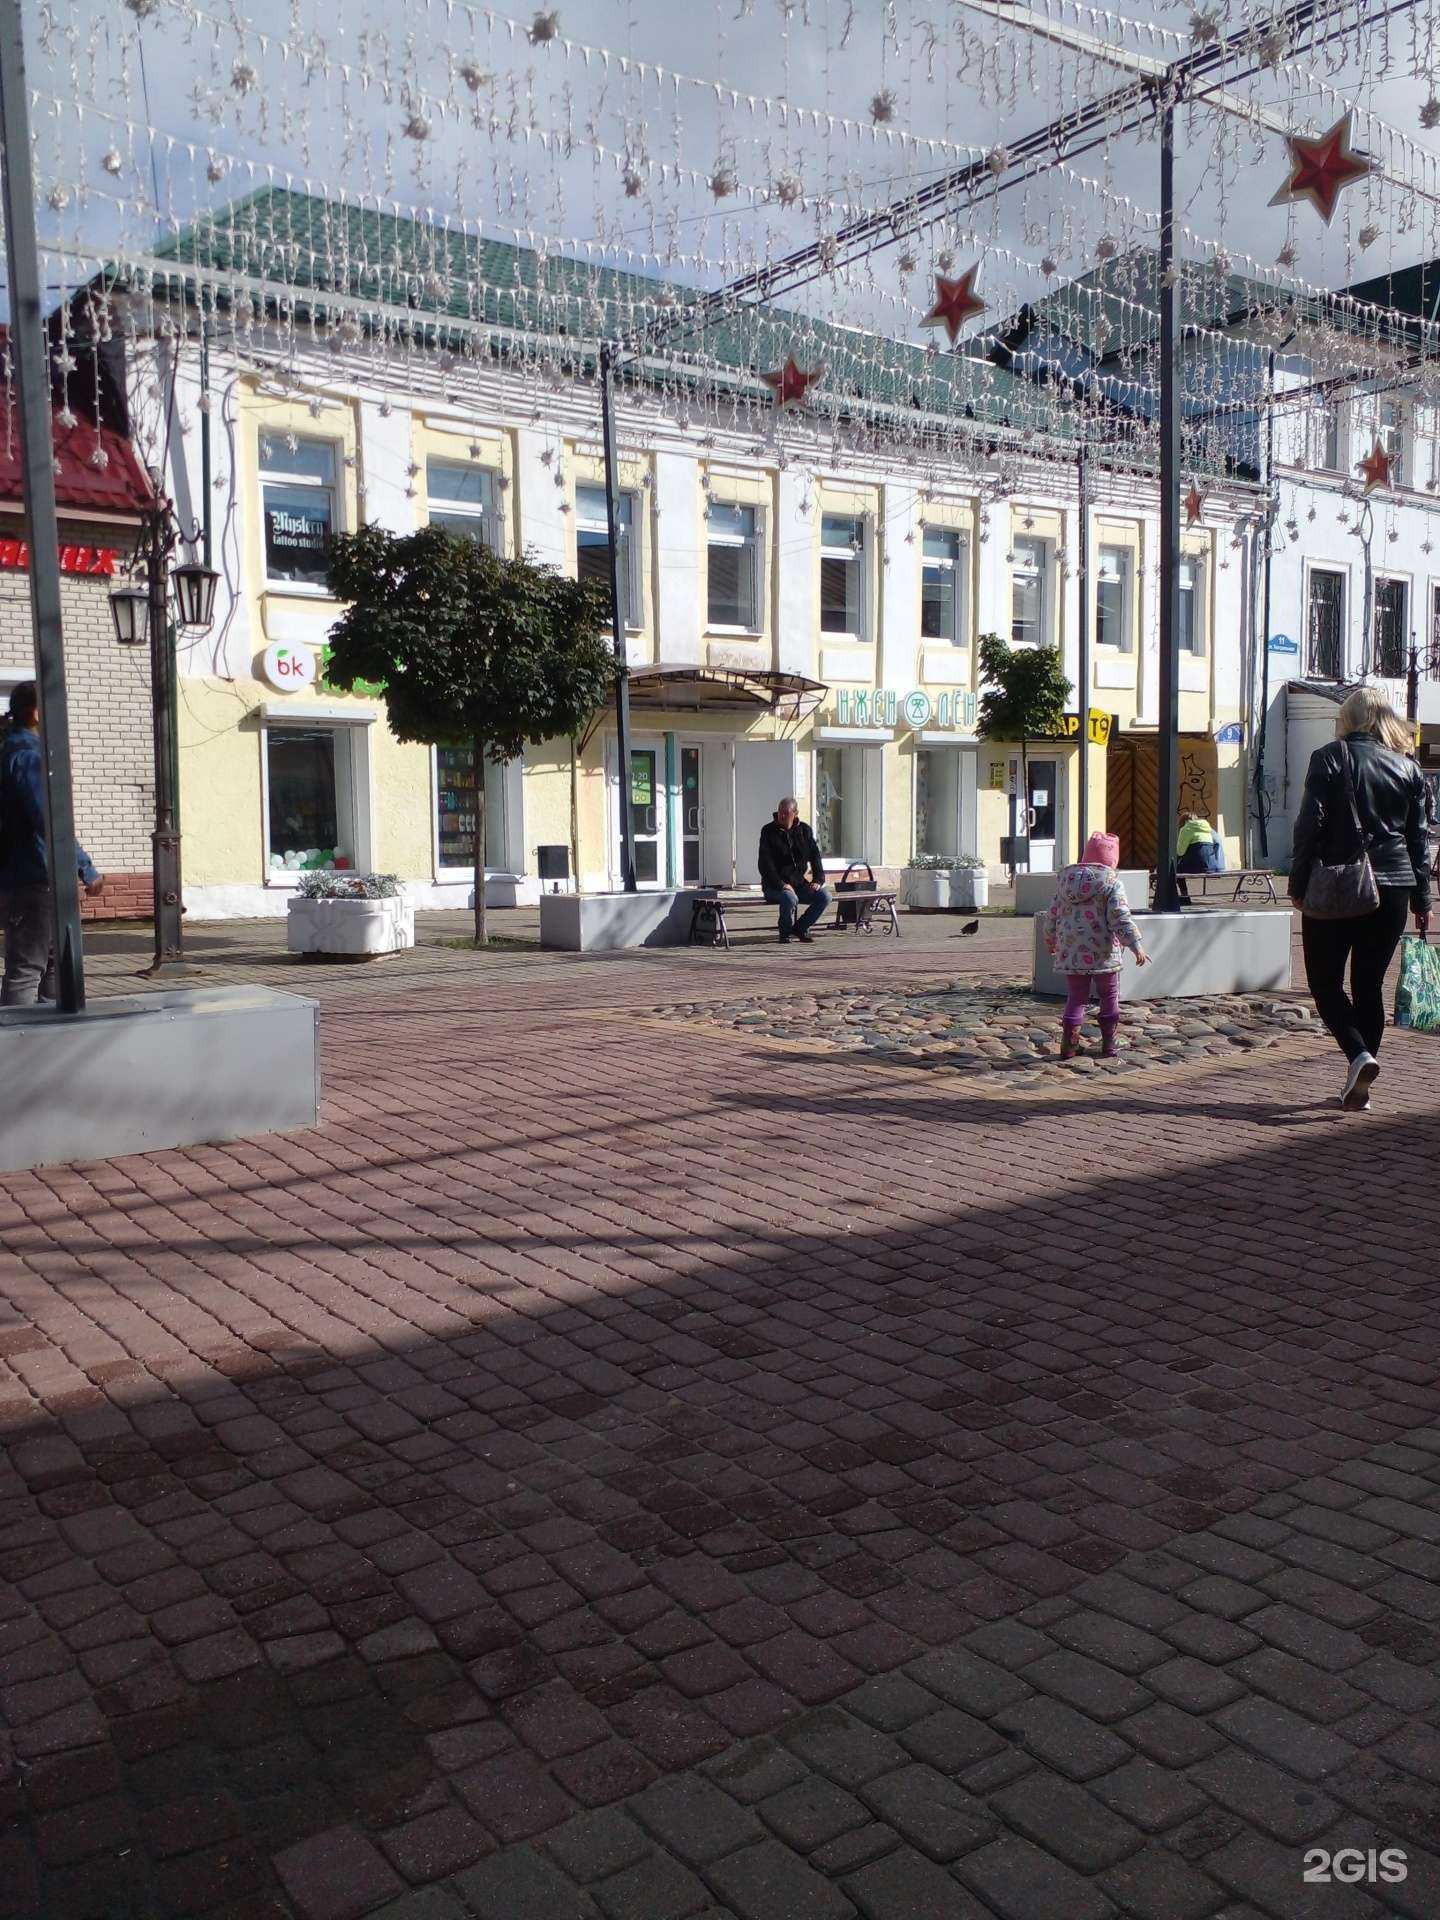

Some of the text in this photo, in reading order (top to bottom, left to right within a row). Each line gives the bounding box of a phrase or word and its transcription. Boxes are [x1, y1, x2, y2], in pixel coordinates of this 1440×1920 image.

[272, 535, 298, 547] tattoo
[1278, 636, 1286, 646] 11
[1227, 727, 1233, 740] 9
